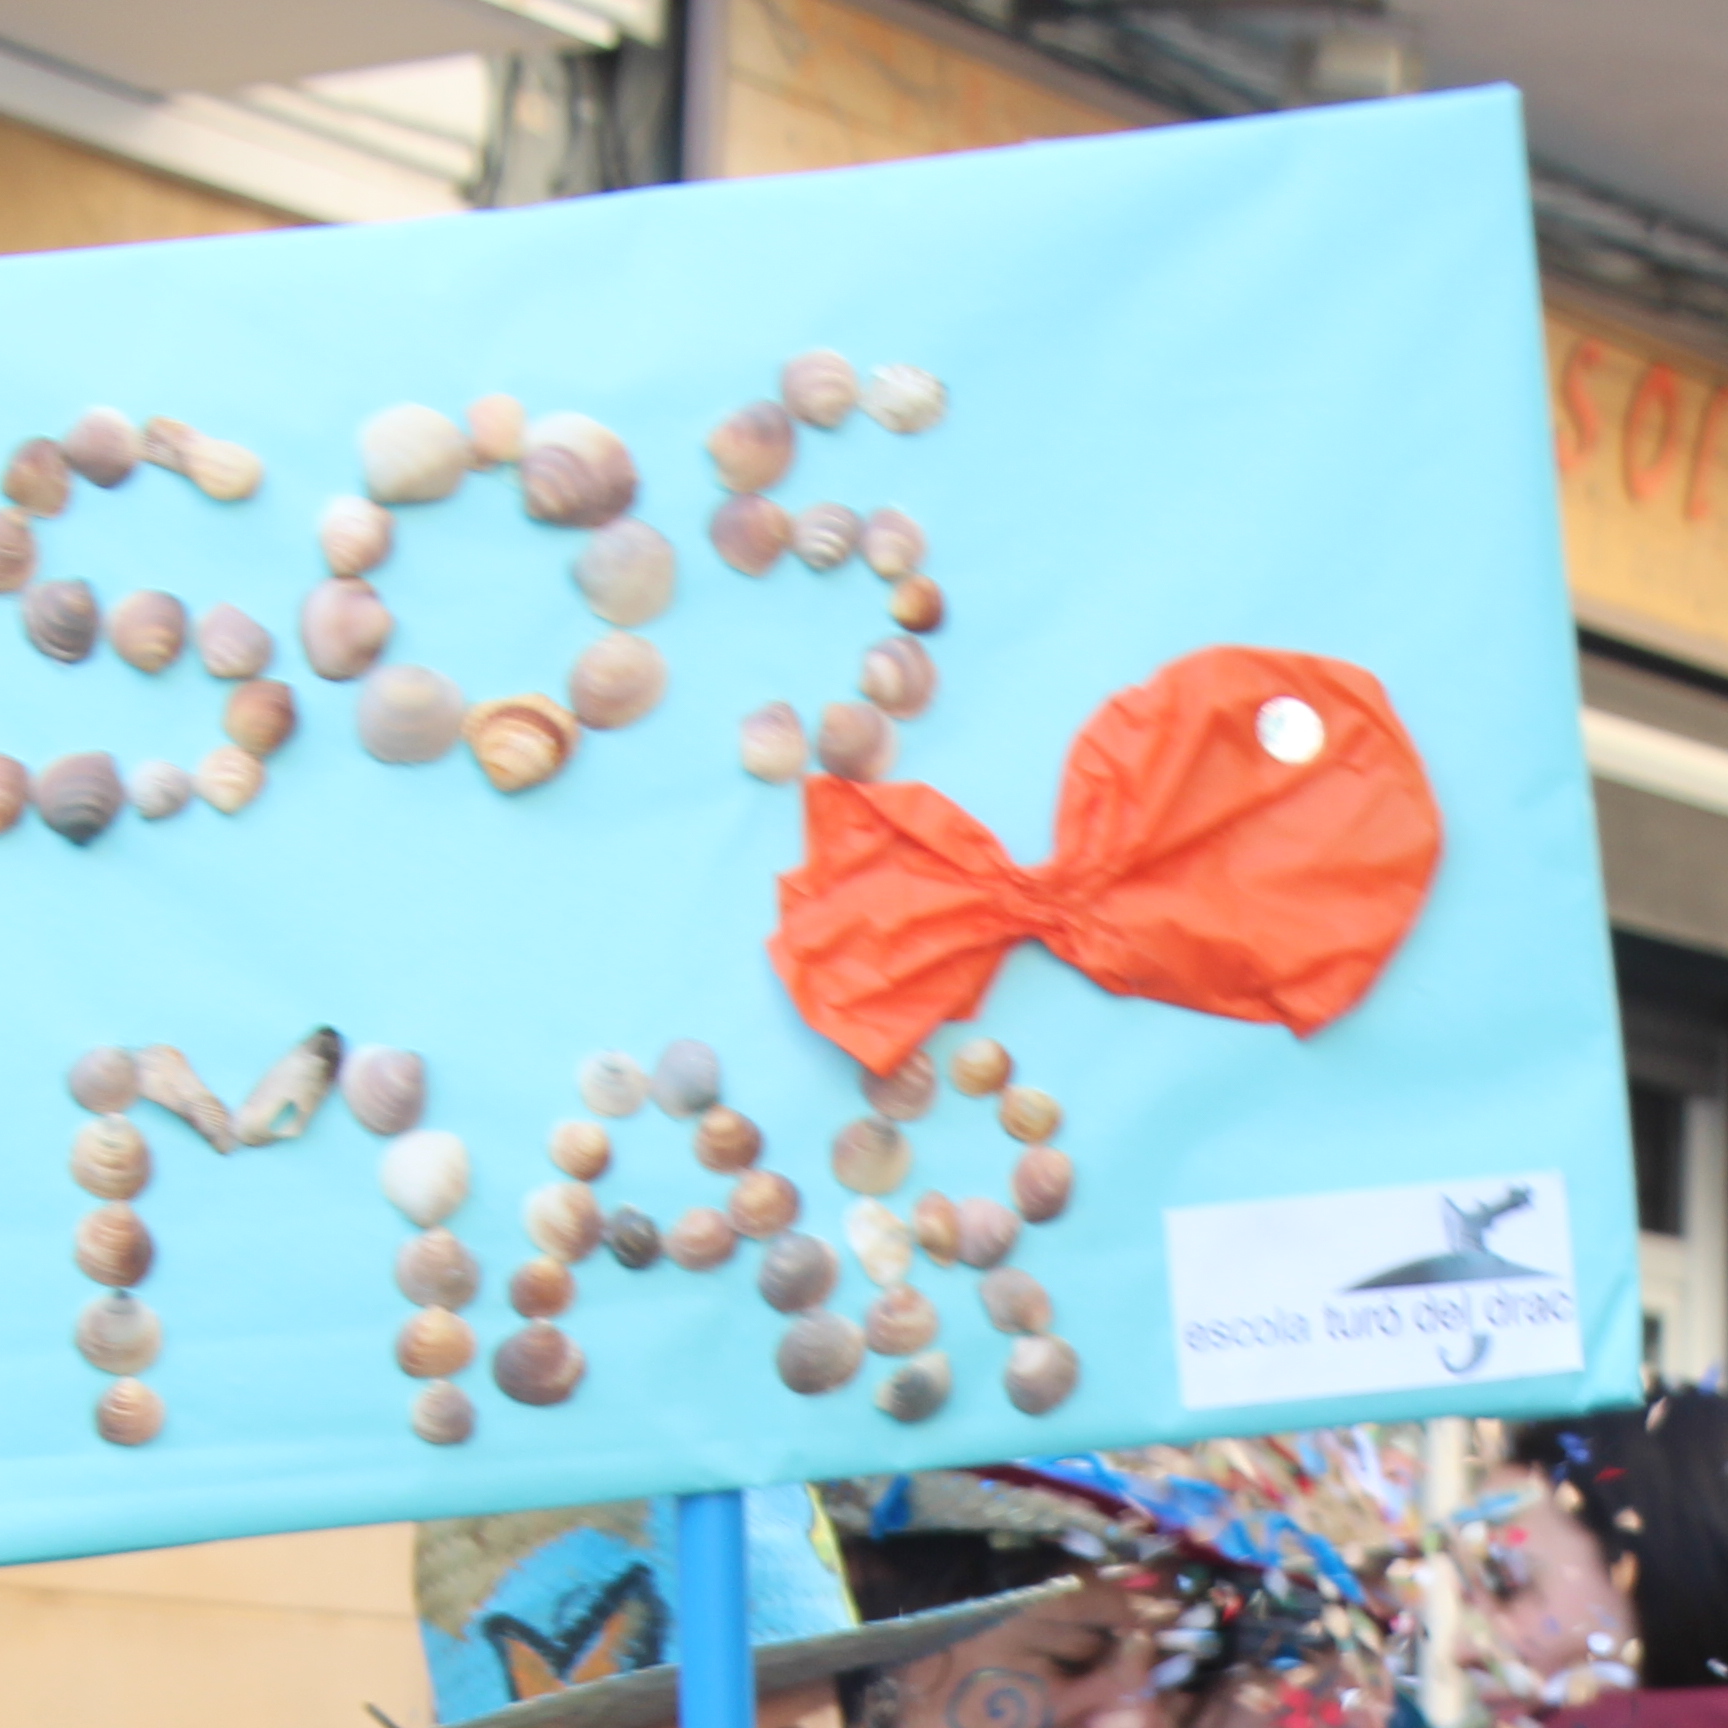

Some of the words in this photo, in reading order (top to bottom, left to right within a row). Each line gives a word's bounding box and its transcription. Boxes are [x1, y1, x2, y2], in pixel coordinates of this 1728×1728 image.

[70, 1024, 1080, 1448] MAR
[1183, 1305, 1312, 1351] escola
[1411, 1286, 1471, 1335] del
[1482, 1283, 1573, 1328] drac
